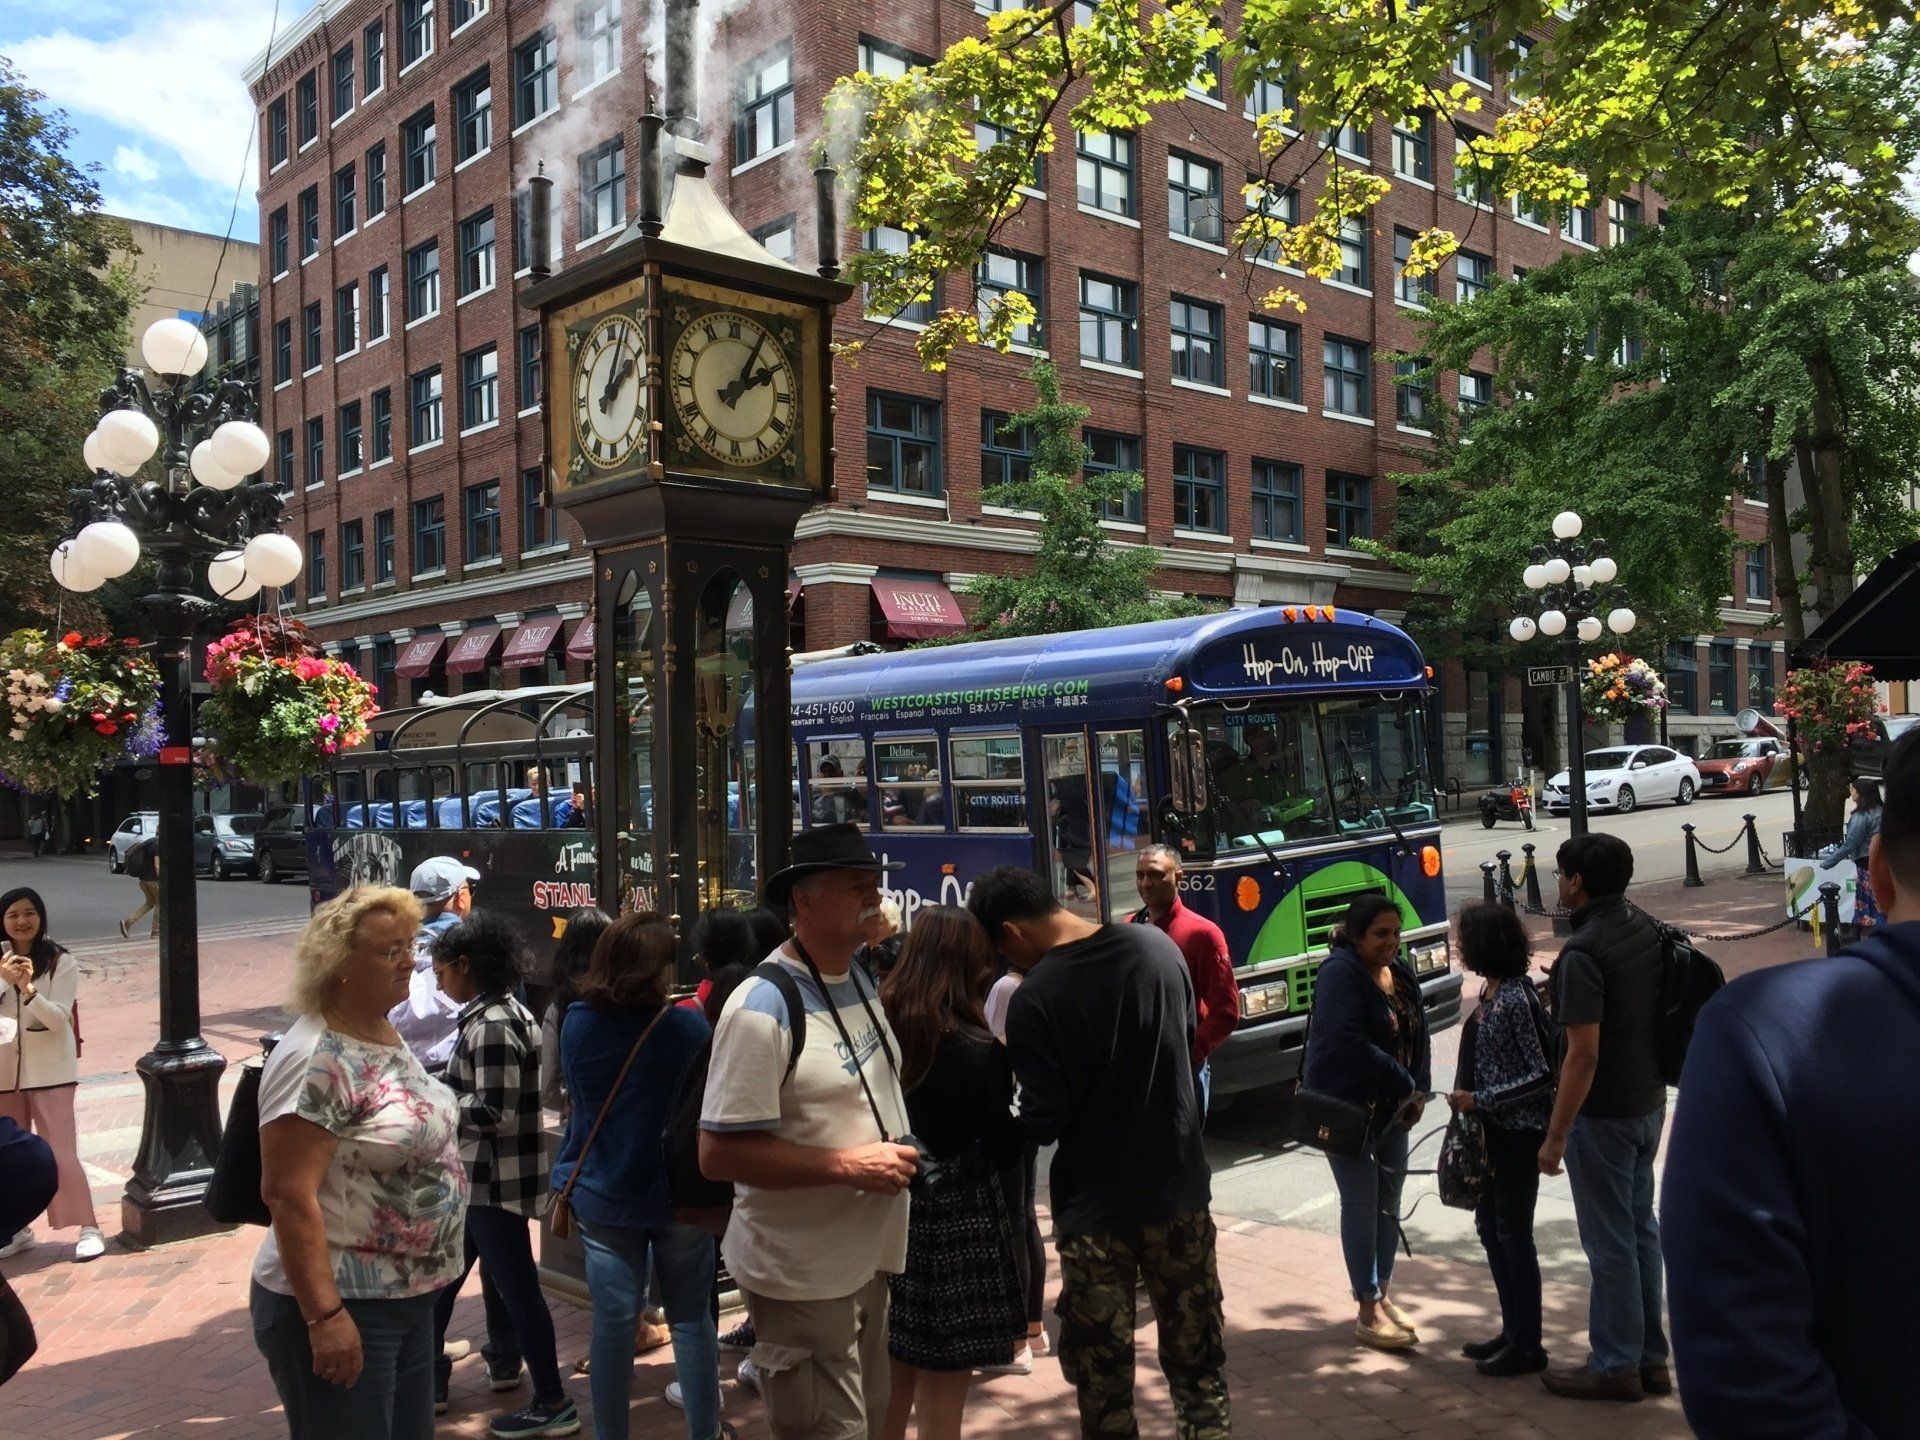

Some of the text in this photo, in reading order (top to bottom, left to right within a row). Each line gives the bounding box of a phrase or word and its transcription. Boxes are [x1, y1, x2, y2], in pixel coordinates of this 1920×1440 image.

[892, 591, 942, 608] INUIT
[1243, 641, 1374, 685] Hop-On, Hop-Off
[1532, 670, 1555, 682] CAMBIE
[871, 680, 1089, 711] WESTCOASTSIGHTSEEING.COM
[791, 700, 855, 716] 4-451-1600
[791, 718, 816, 726] MENTARY
[830, 715, 855, 724] English
[860, 712, 889, 720] Français
[931, 706, 962, 717] Deutsch
[1225, 713, 1277, 725] CITY ROUTE
[970, 795, 1020, 805] CITY ROUTE
[566, 841, 598, 872] Fami
[533, 880, 597, 910] STANL
